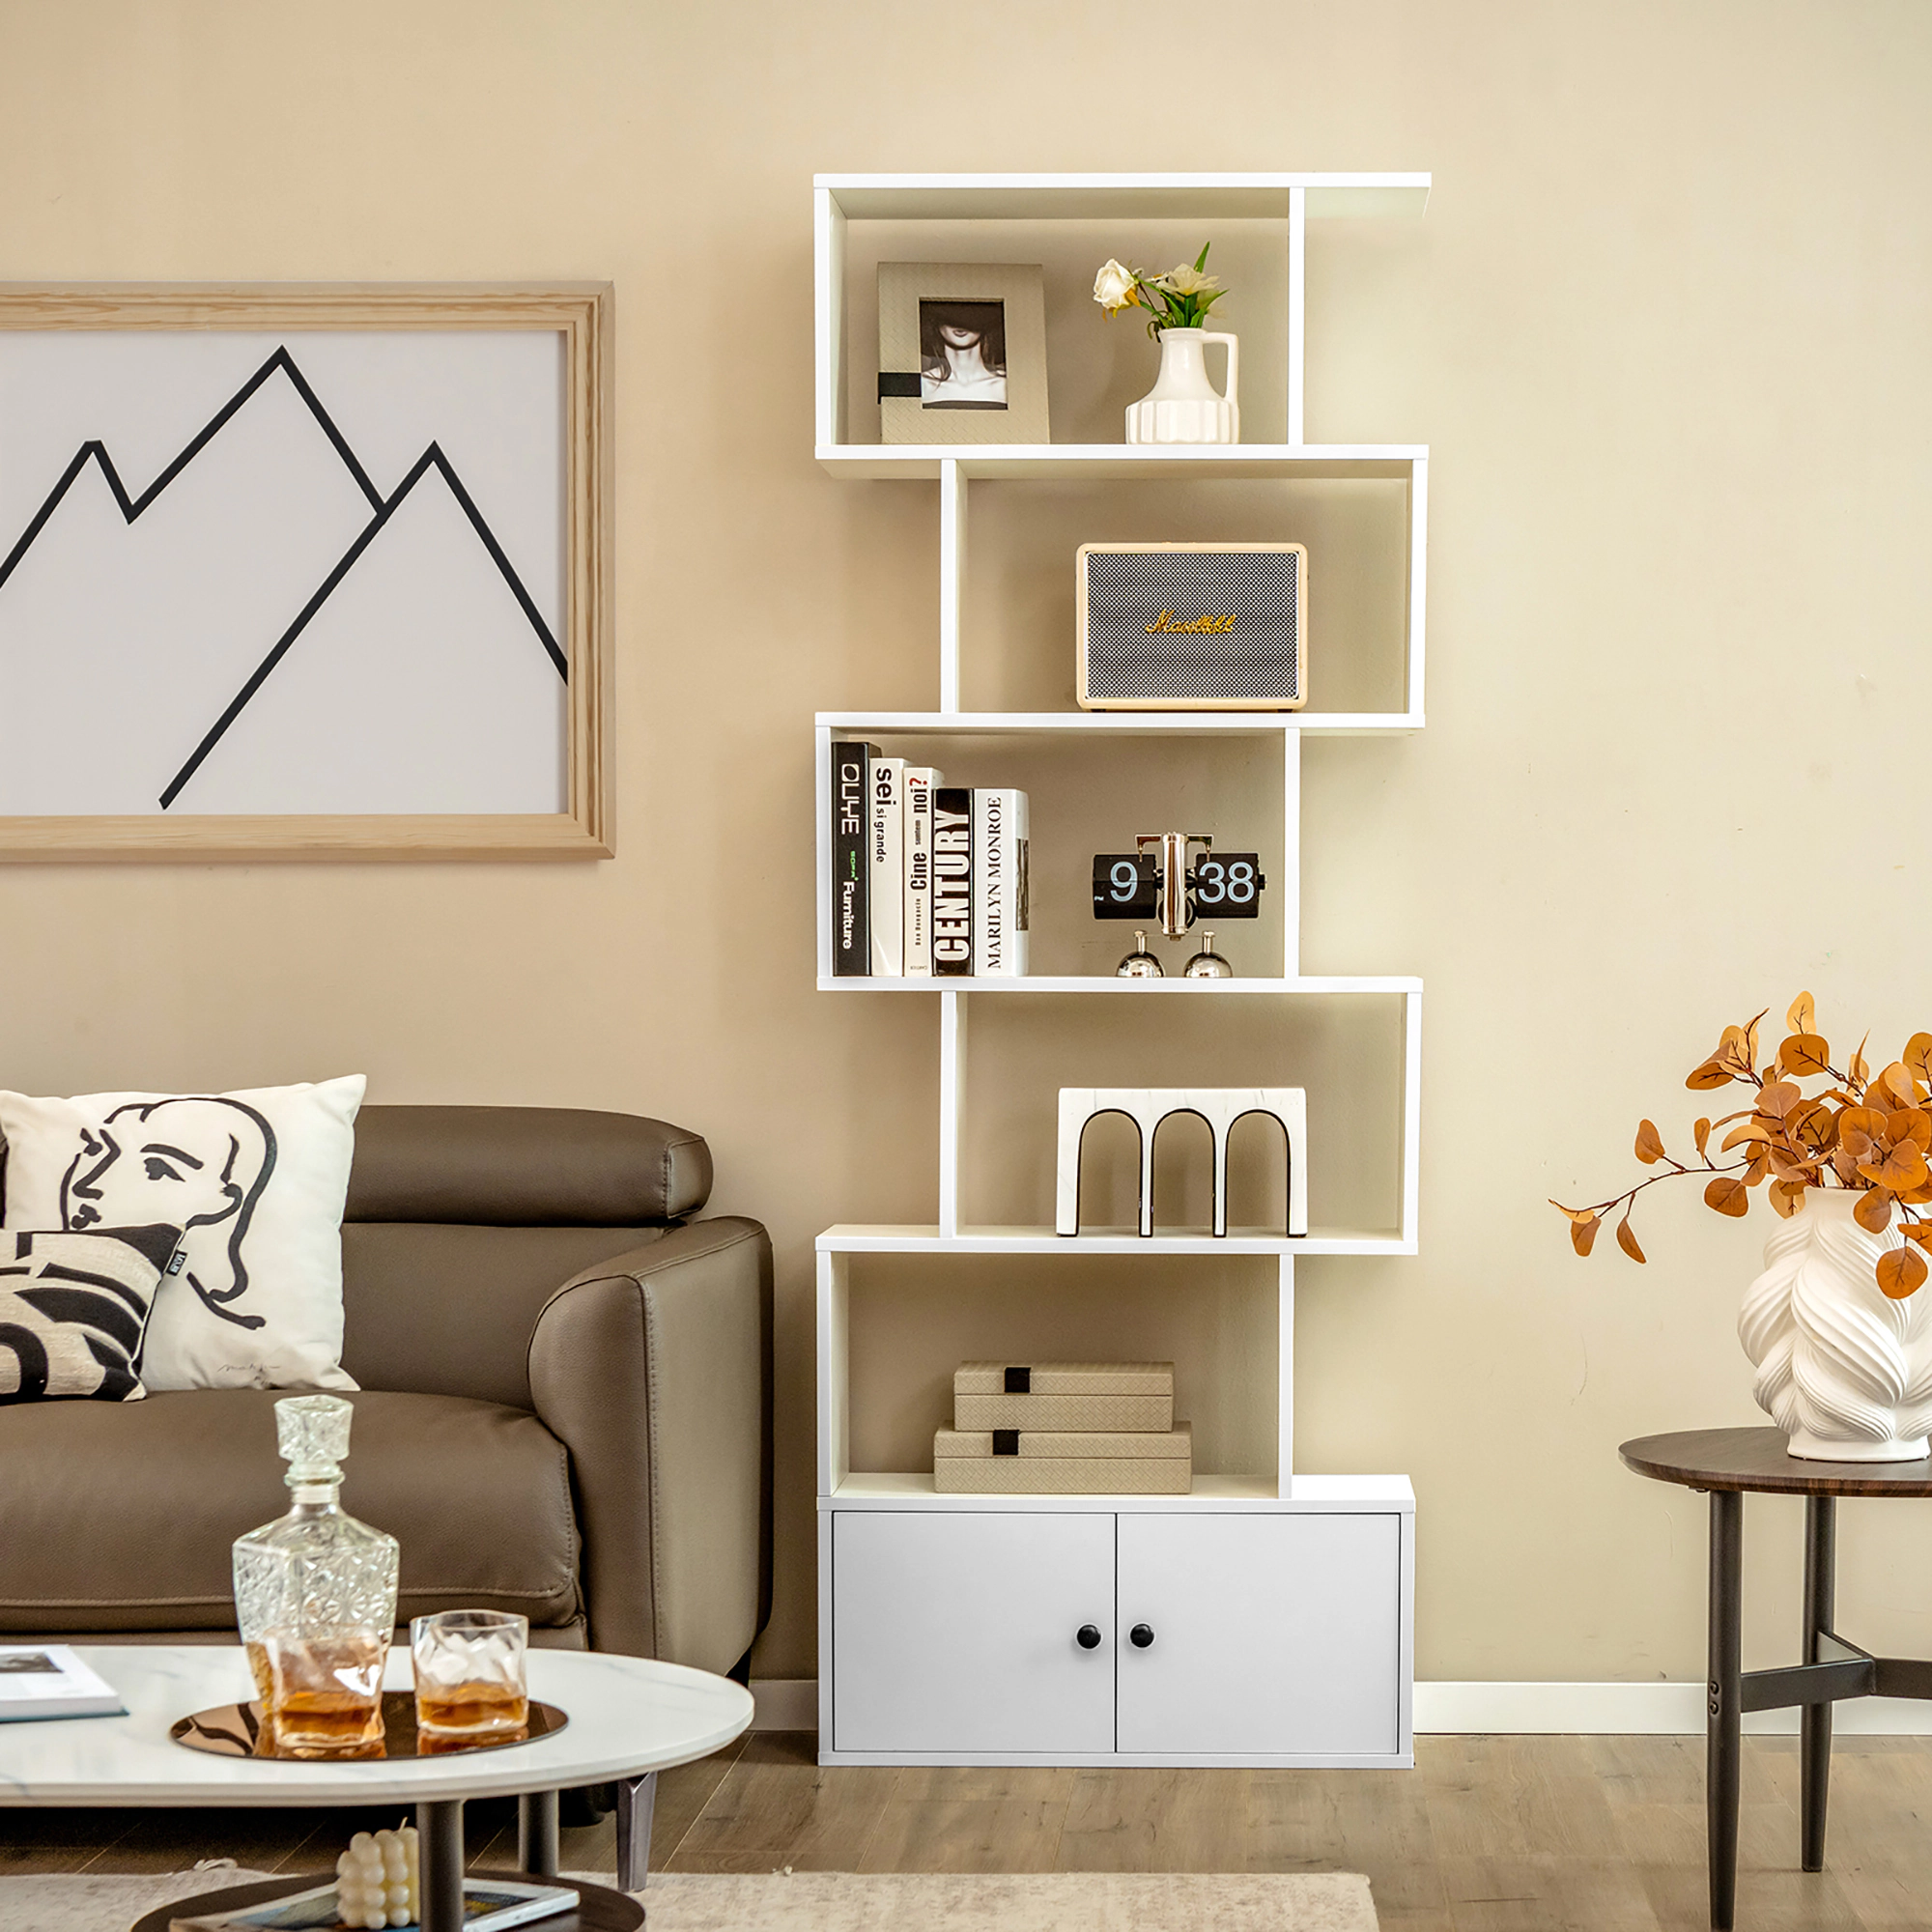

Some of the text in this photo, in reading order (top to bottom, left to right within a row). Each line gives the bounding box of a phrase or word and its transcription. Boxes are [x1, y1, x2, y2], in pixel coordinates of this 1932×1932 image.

[873, 767, 897, 863] sei si grande
[909, 777, 928, 813] noi?
[910, 852, 927, 890] Cine
[933, 808, 970, 961] CENTURY
[986, 796, 1002, 969] MARILYN MONROE
[1109, 861, 1139, 902] 9
[1197, 862, 1256, 903] 38
[842, 881, 855, 950] Furniture
